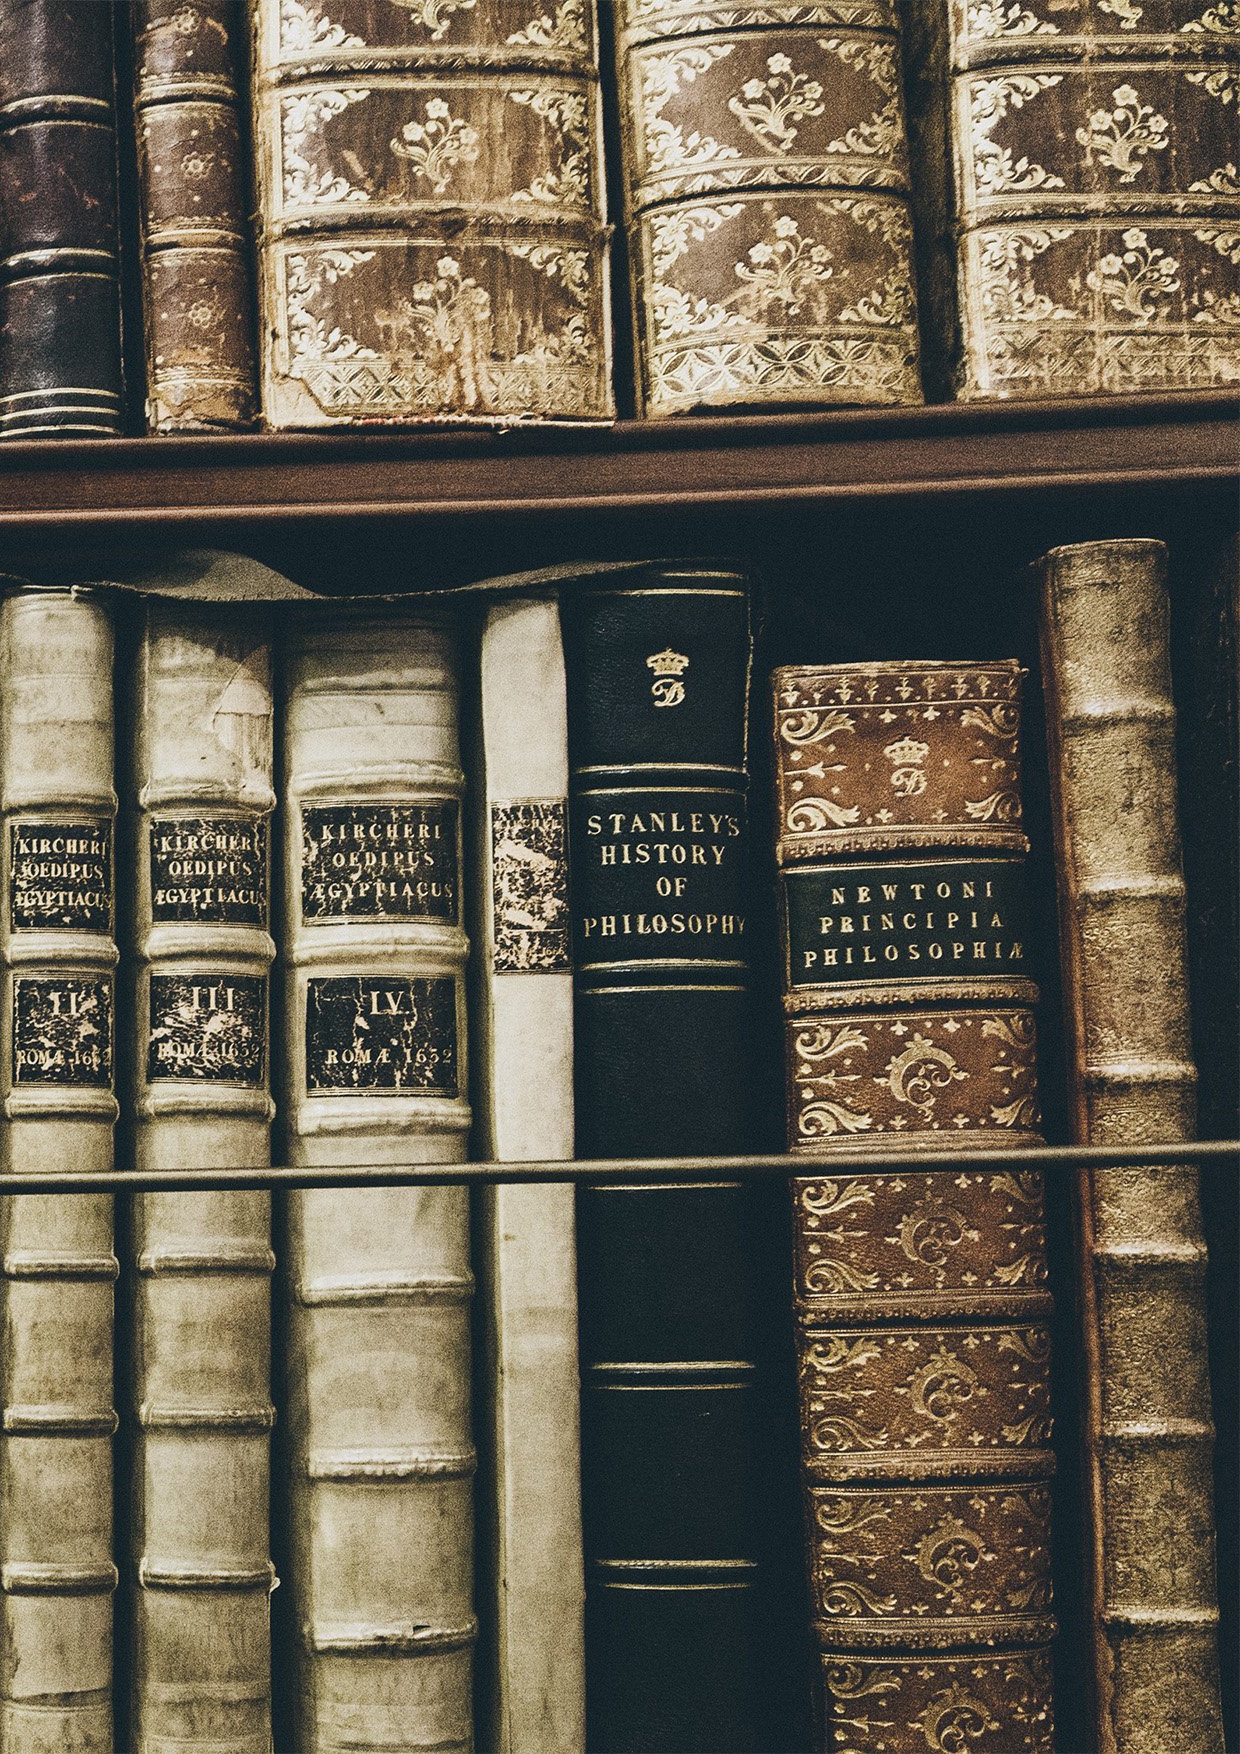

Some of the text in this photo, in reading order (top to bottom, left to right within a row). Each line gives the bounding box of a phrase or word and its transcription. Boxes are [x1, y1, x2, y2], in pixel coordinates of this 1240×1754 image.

[323, 824, 441, 841] KIRCHERI
[587, 812, 741, 837] STANLEY'S
[18, 838, 106, 856] KIRCHERI
[601, 843, 726, 865] HISTORY
[168, 860, 252, 876] OEDIPUS
[333, 852, 435, 867] OEDIPUS
[28, 862, 104, 880] OEDIPUS
[657, 877, 688, 897] OF
[832, 882, 995, 905] NEWTONI
[584, 914, 746, 938] PHILOSOPHY
[819, 913, 1004, 934] PRINCIPIA
[803, 941, 1024, 968] PHILOSOPHIÆ
[52, 991, 78, 1016] II
[192, 986, 235, 1011] III
[370, 990, 403, 1015] IV
[326, 1048, 452, 1064] ROMÆ 1652
